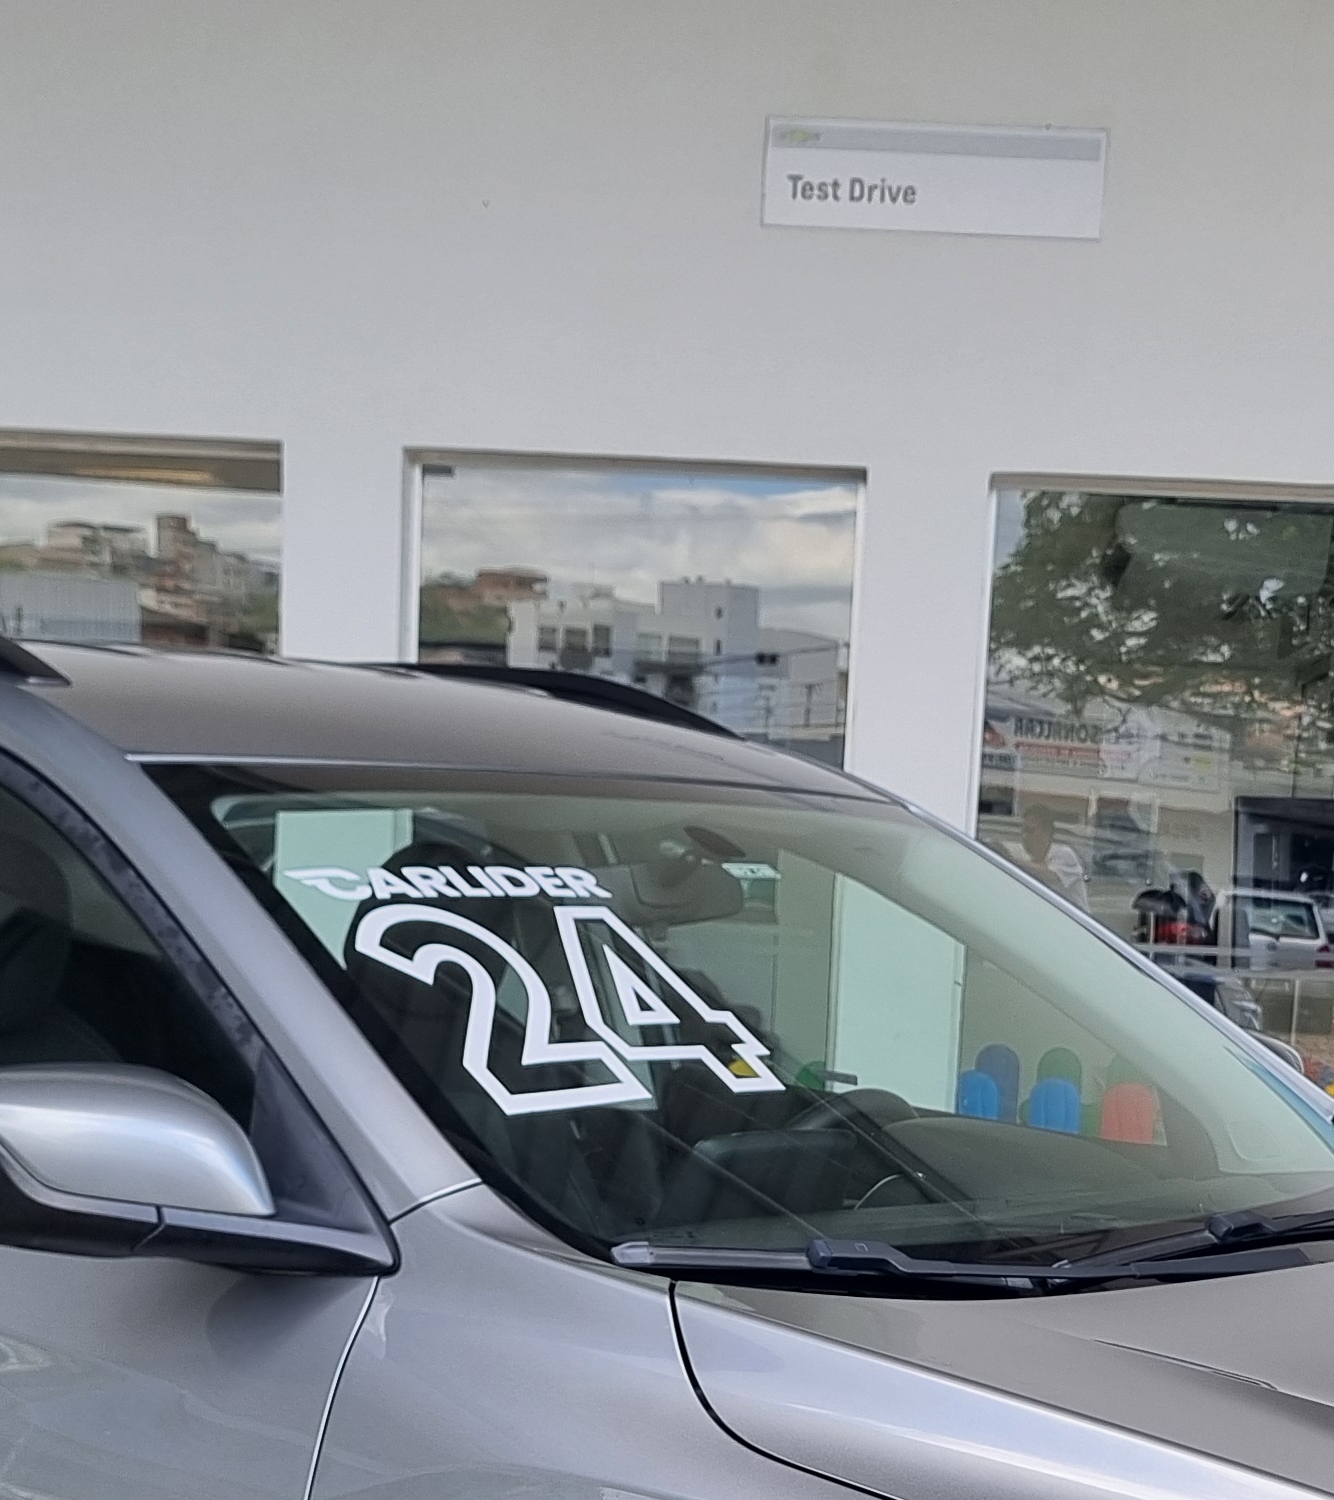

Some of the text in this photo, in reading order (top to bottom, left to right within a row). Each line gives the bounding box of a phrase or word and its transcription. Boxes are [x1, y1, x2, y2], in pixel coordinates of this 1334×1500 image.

[786, 173, 918, 206] Test Drive
[283, 864, 613, 900] CARLIDER
[354, 902, 786, 1117] 24
